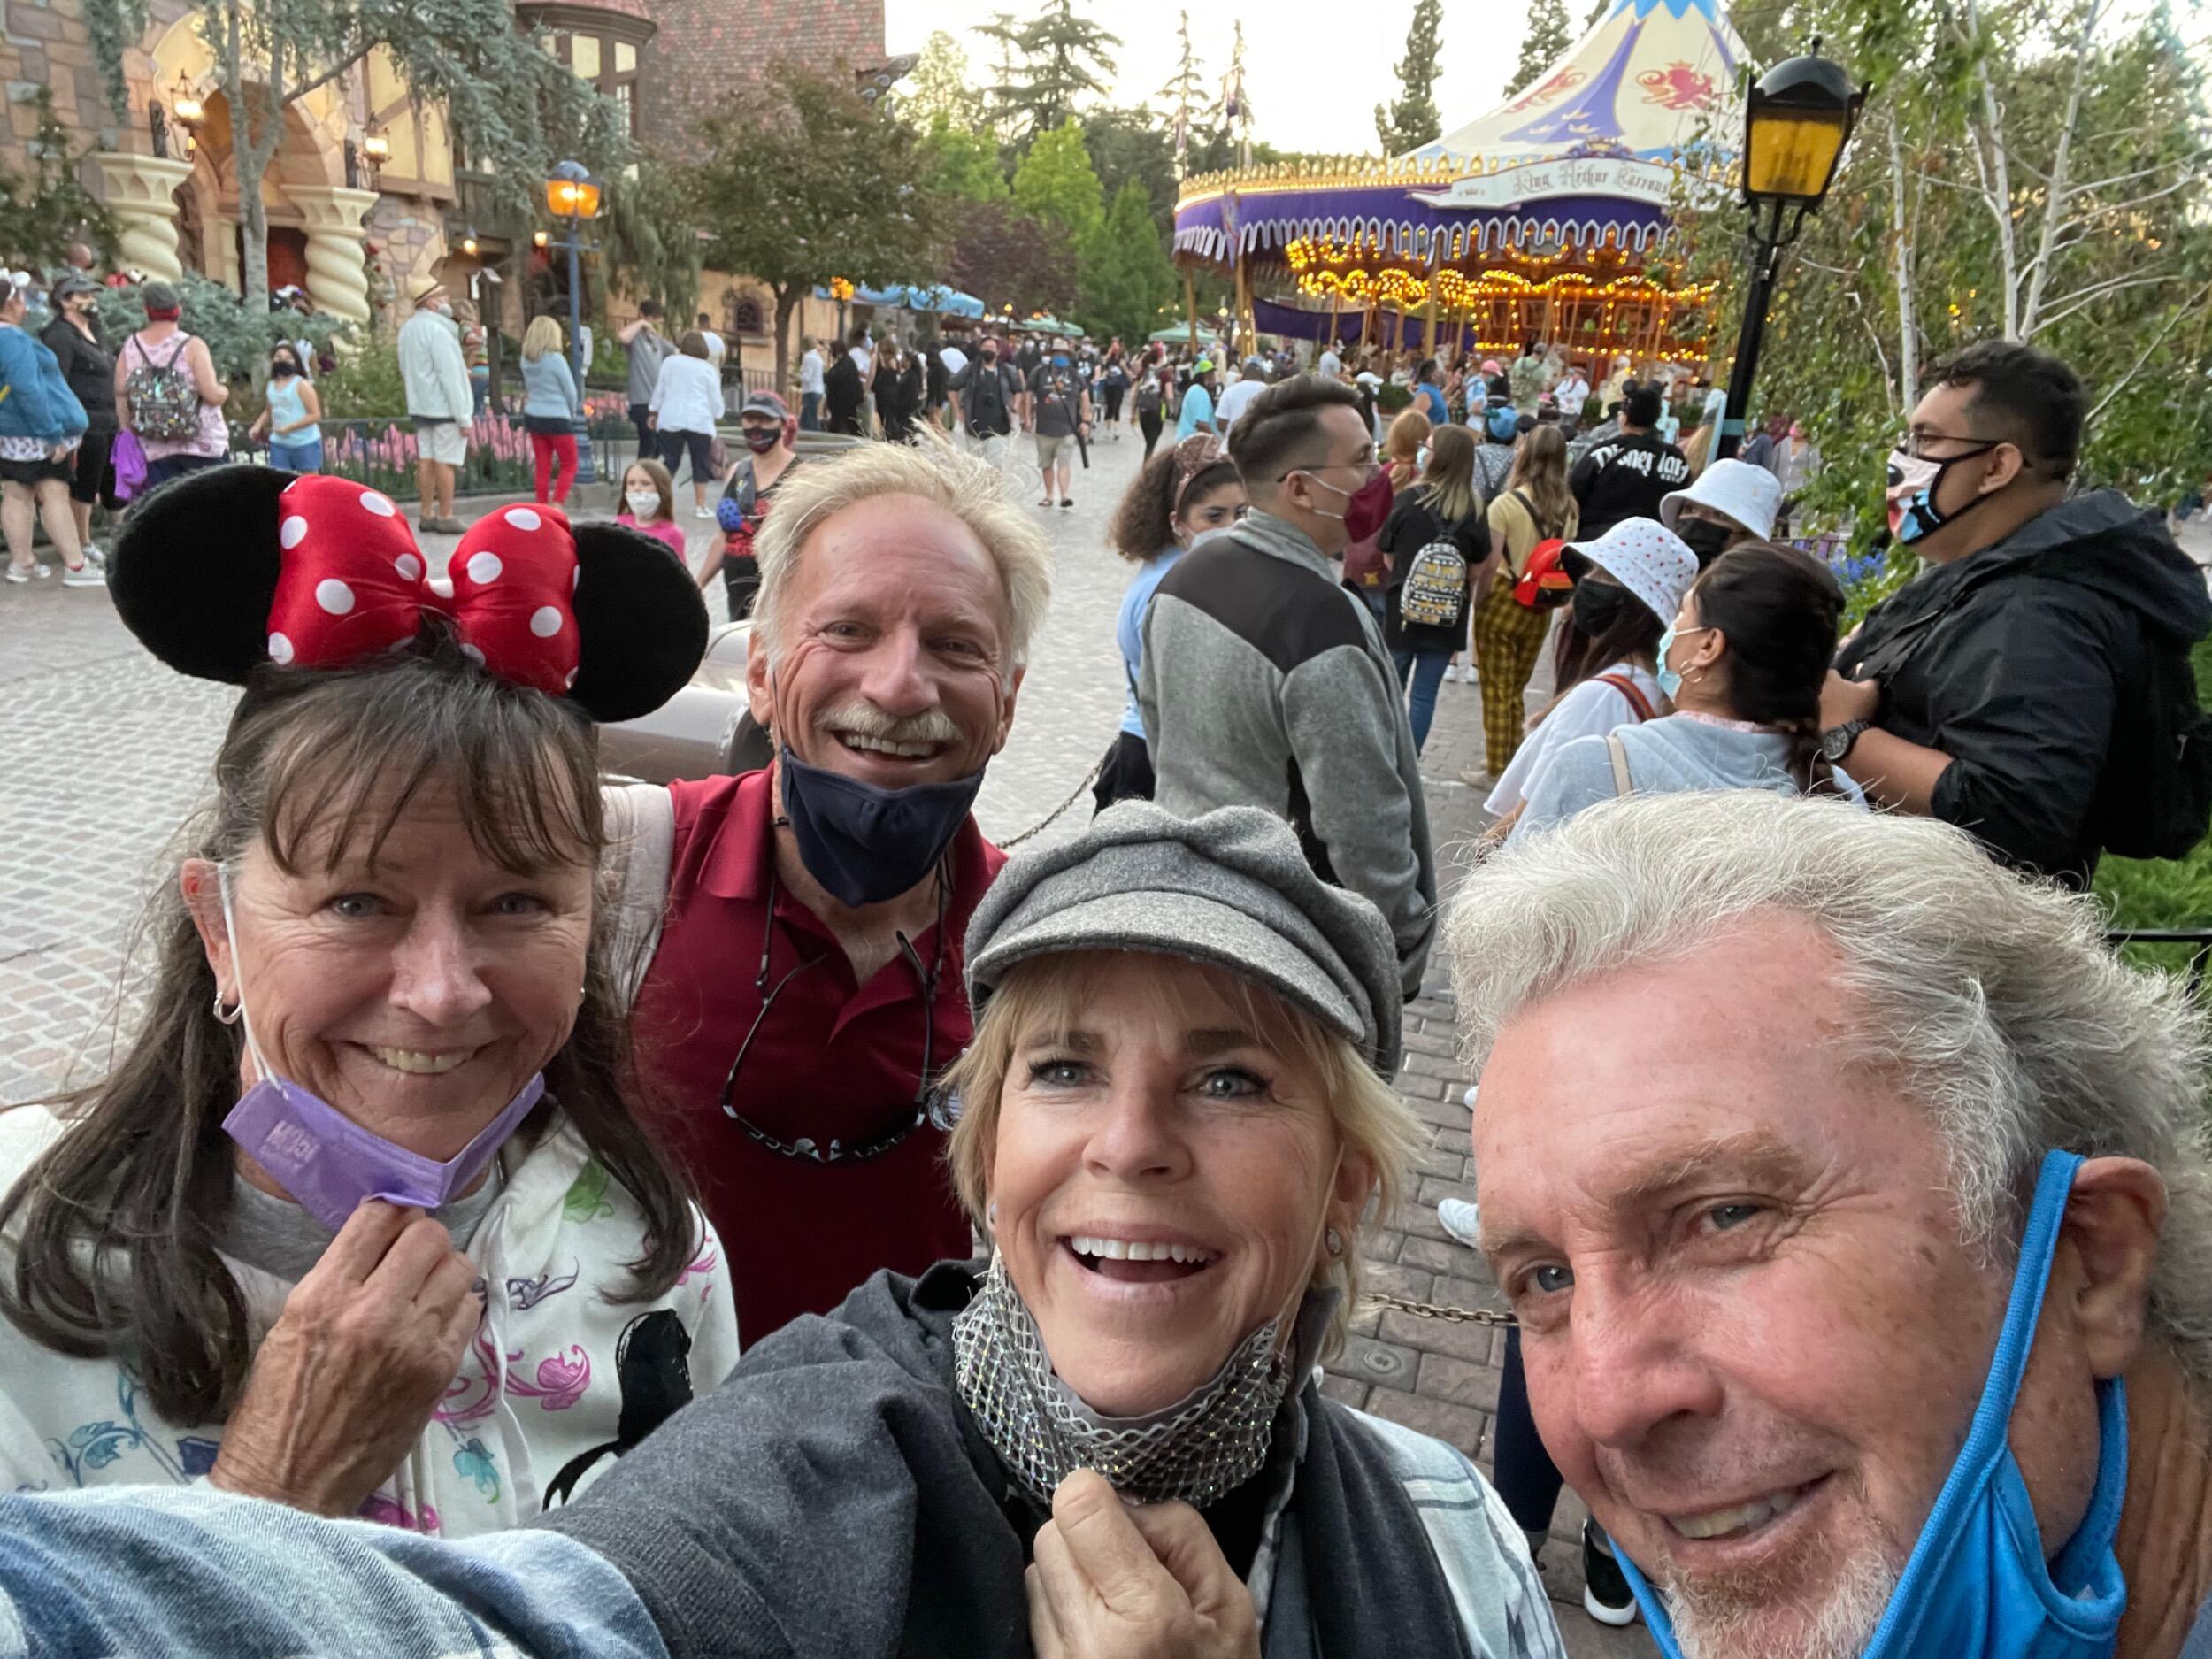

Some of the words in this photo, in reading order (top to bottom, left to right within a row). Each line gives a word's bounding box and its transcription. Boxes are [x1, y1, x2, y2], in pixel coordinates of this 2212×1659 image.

[1513, 168, 1554, 195] King
[1558, 159, 1609, 190] Arthur
[1613, 163, 1671, 194] Carrous
